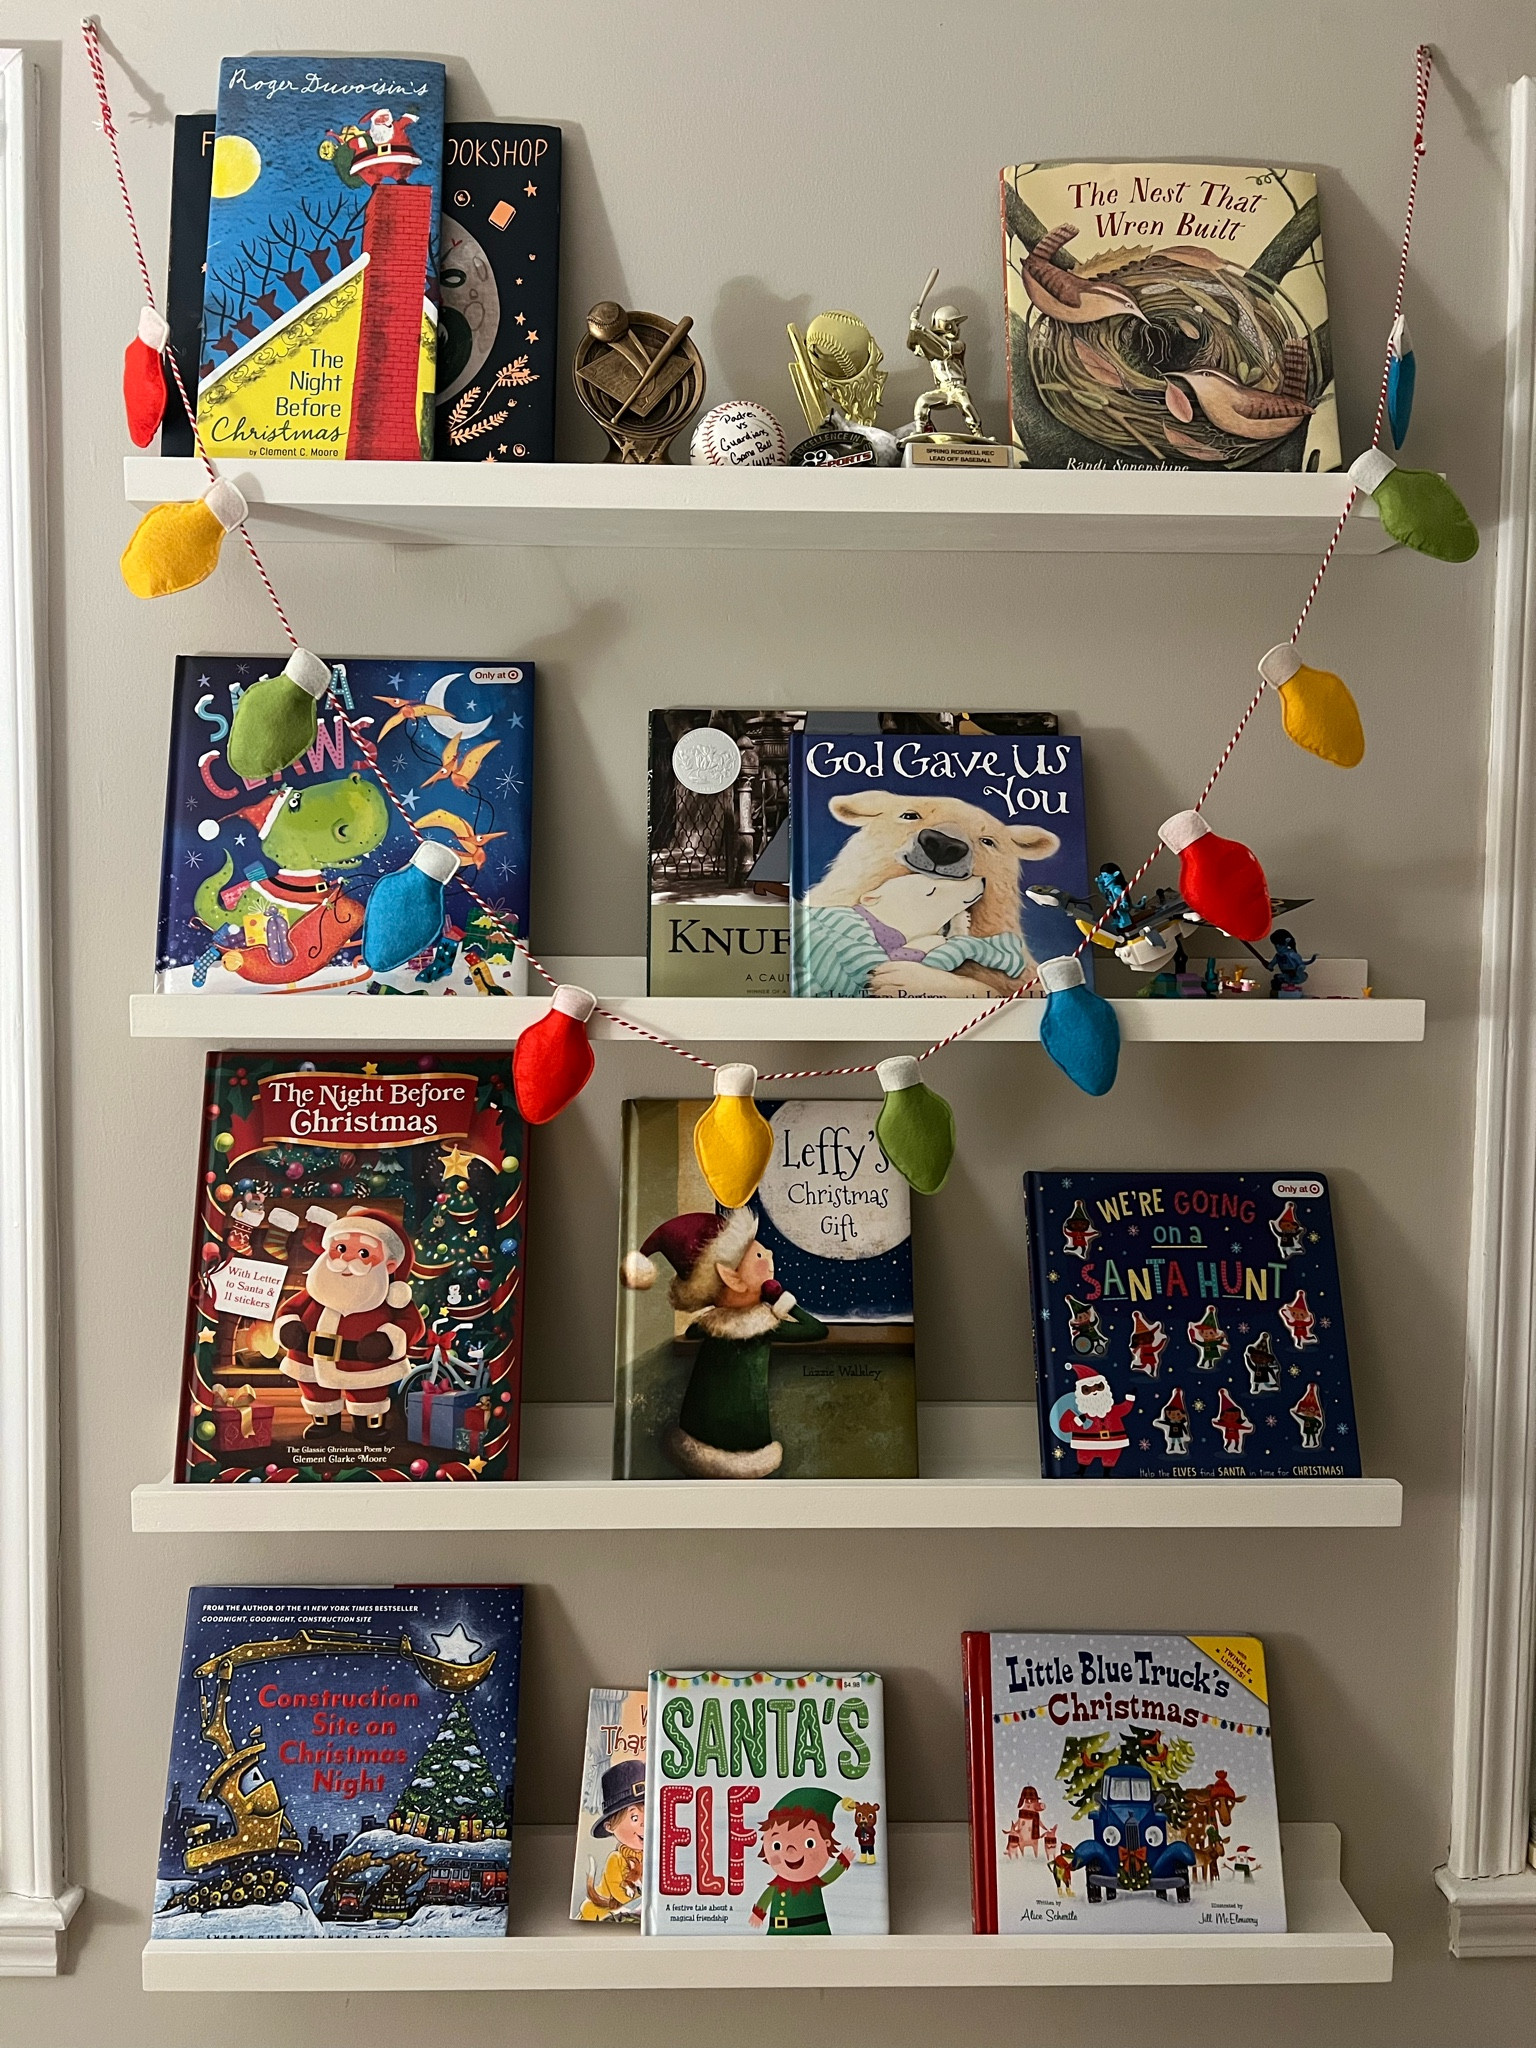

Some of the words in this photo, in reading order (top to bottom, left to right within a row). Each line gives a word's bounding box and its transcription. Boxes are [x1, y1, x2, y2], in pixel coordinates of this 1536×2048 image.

[229, 68, 298, 99] Roger
[301, 72, 429, 96] Duvoisin's
[1068, 181, 1118, 209] The
[1130, 177, 1191, 203] Nest
[1200, 181, 1267, 214] That
[1096, 211, 1164, 237] Wren
[1175, 211, 1246, 241] Built
[310, 349, 344, 369] The
[290, 371, 342, 395] Night
[276, 397, 341, 417] Before
[211, 416, 347, 442] Christmas
[249, 449, 257, 457] by
[259, 447, 297, 457] Clement
[300, 447, 308, 457] C.
[311, 448, 339, 457] Moore
[475, 671, 495, 680] Only
[806, 741, 884, 778] God
[893, 742, 1006, 779] Gave
[983, 775, 1070, 817] You
[745, 973, 753, 982] A
[268, 1082, 314, 1107] The
[318, 1082, 384, 1111] Night
[389, 1082, 466, 1108] Before
[290, 1109, 438, 1136] Christmas
[782, 1126, 889, 1181] Leffy's
[788, 1181, 889, 1208] Christmas
[1277, 1184, 1297, 1194] Only
[1299, 1185, 1308, 1193] at
[1096, 1188, 1165, 1224] WE'RE
[1174, 1190, 1257, 1224] GOING
[821, 1213, 858, 1242] Gift
[1154, 1226, 1181, 1243] on
[1189, 1226, 1202, 1243] a
[226, 1280, 234, 1289] to
[237, 1281, 263, 1294] Santa
[267, 1287, 275, 1297] &
[228, 1266, 250, 1279] With
[253, 1271, 281, 1285] Letter
[1081, 1258, 1189, 1301] SANTA
[1197, 1260, 1287, 1300] HUNT
[234, 1294, 270, 1309] stickers
[293, 1455, 326, 1463] Clement
[328, 1455, 355, 1463] Clarke
[357, 1455, 387, 1463] Moore
[364, 1445, 382, 1453] Poem
[384, 1445, 395, 1453] by
[1172, 1467, 1197, 1477] ELVES
[1218, 1467, 1246, 1476] SANTA
[1292, 1466, 1344, 1476] CHRISTMAS!
[1224, 1646, 1252, 1675] TWINKLE
[1005, 1655, 1073, 1693] Little
[1078, 1651, 1133, 1685] Blue
[1134, 1651, 1231, 1698] Truck's
[258, 1683, 420, 1709] Construction
[1048, 1692, 1200, 1728] Christmas
[311, 1711, 360, 1736] Site
[365, 1720, 398, 1736] on
[660, 1697, 872, 1780] SANTA'S
[278, 1739, 408, 1765] Christmas
[312, 1768, 386, 1800] Night
[658, 1785, 761, 1896] ELF
[670, 1914, 695, 1923] magical
[696, 1914, 729, 1923] friendship
[672, 1903, 693, 1911] festive
[1020, 1908, 1043, 1921] Alice
